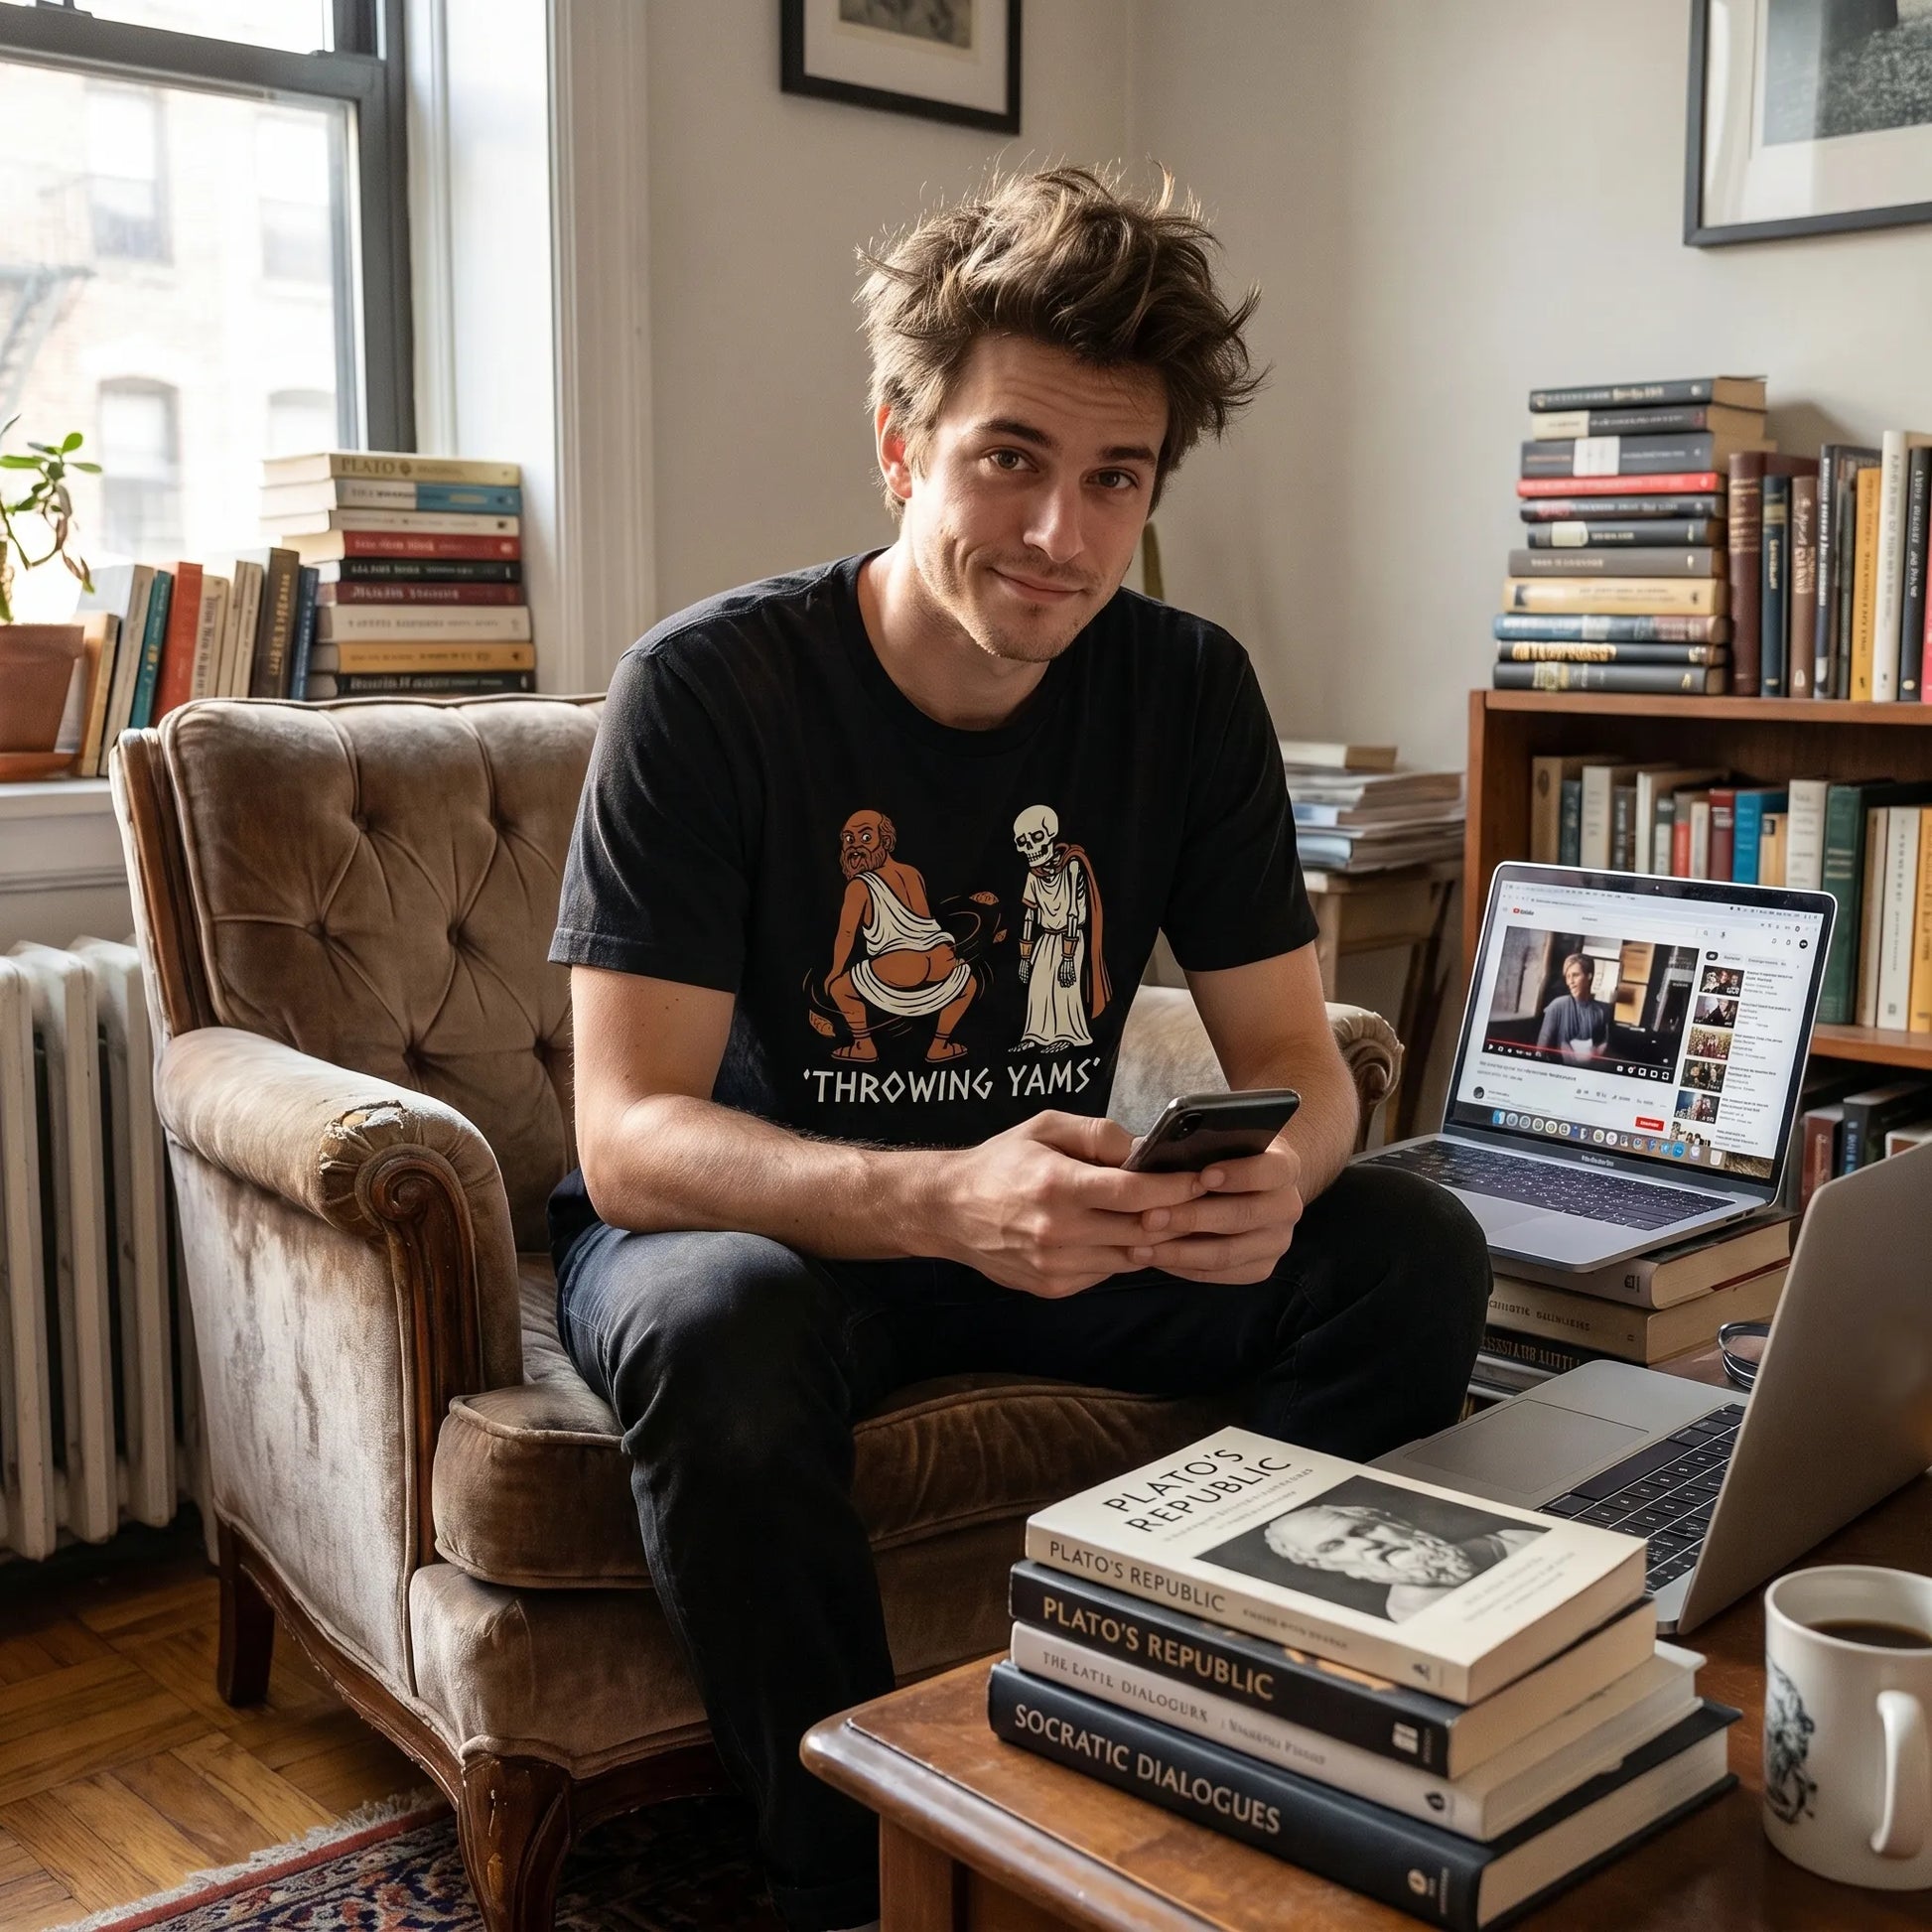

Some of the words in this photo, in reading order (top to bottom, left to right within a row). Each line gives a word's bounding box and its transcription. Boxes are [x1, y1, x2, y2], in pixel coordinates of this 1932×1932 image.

[341, 457, 396, 475] PLATO
[1102, 1449, 1243, 1513] PLATO'S
[1124, 1456, 1292, 1532] REPUBLIC
[1049, 1541, 1124, 1580] PLATO'S
[1130, 1566, 1226, 1613] REPUBLIC
[1042, 1651, 1068, 1672] THE
[1043, 1595, 1140, 1652] PLATO'S
[1147, 1633, 1275, 1701] REPUBLIC
[1014, 1704, 1130, 1771] SOCRATIC
[1136, 1753, 1282, 1835] DIALOGUES
